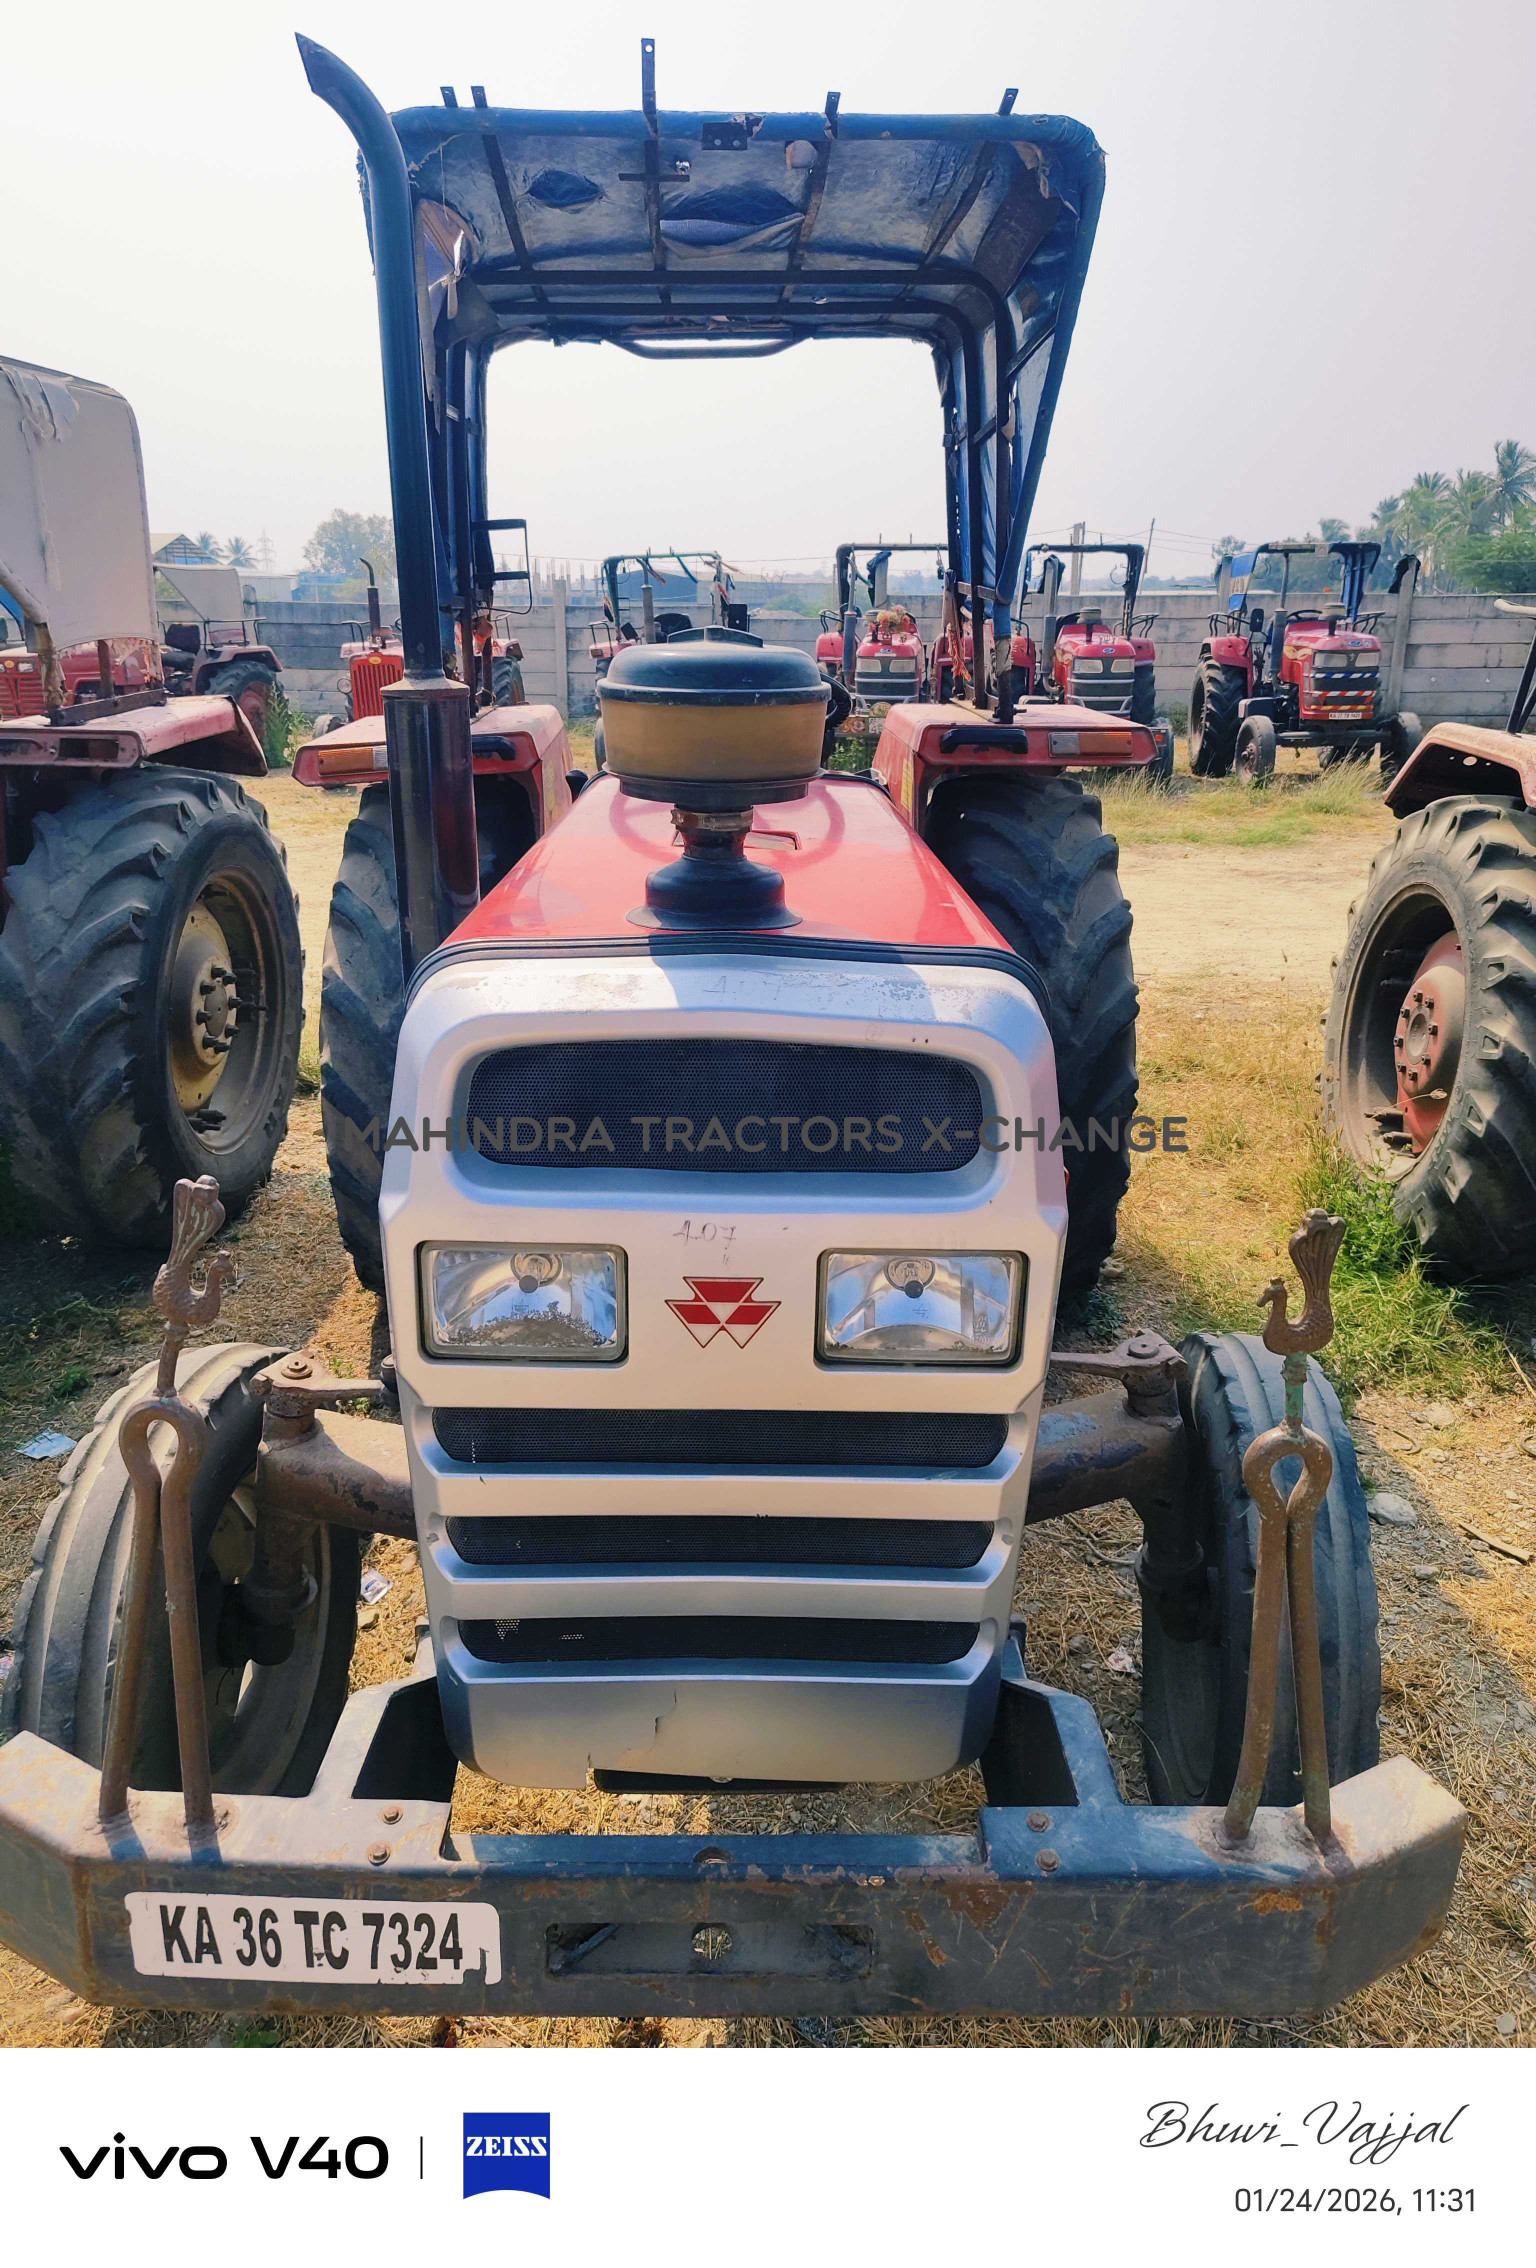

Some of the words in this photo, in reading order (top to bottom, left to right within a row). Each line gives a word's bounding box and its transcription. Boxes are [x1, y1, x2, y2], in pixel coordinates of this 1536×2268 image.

[159, 1905, 223, 1965] KA
[233, 1907, 282, 1968] 36
[293, 1910, 349, 1970] TC
[362, 1912, 463, 1970] 7324
